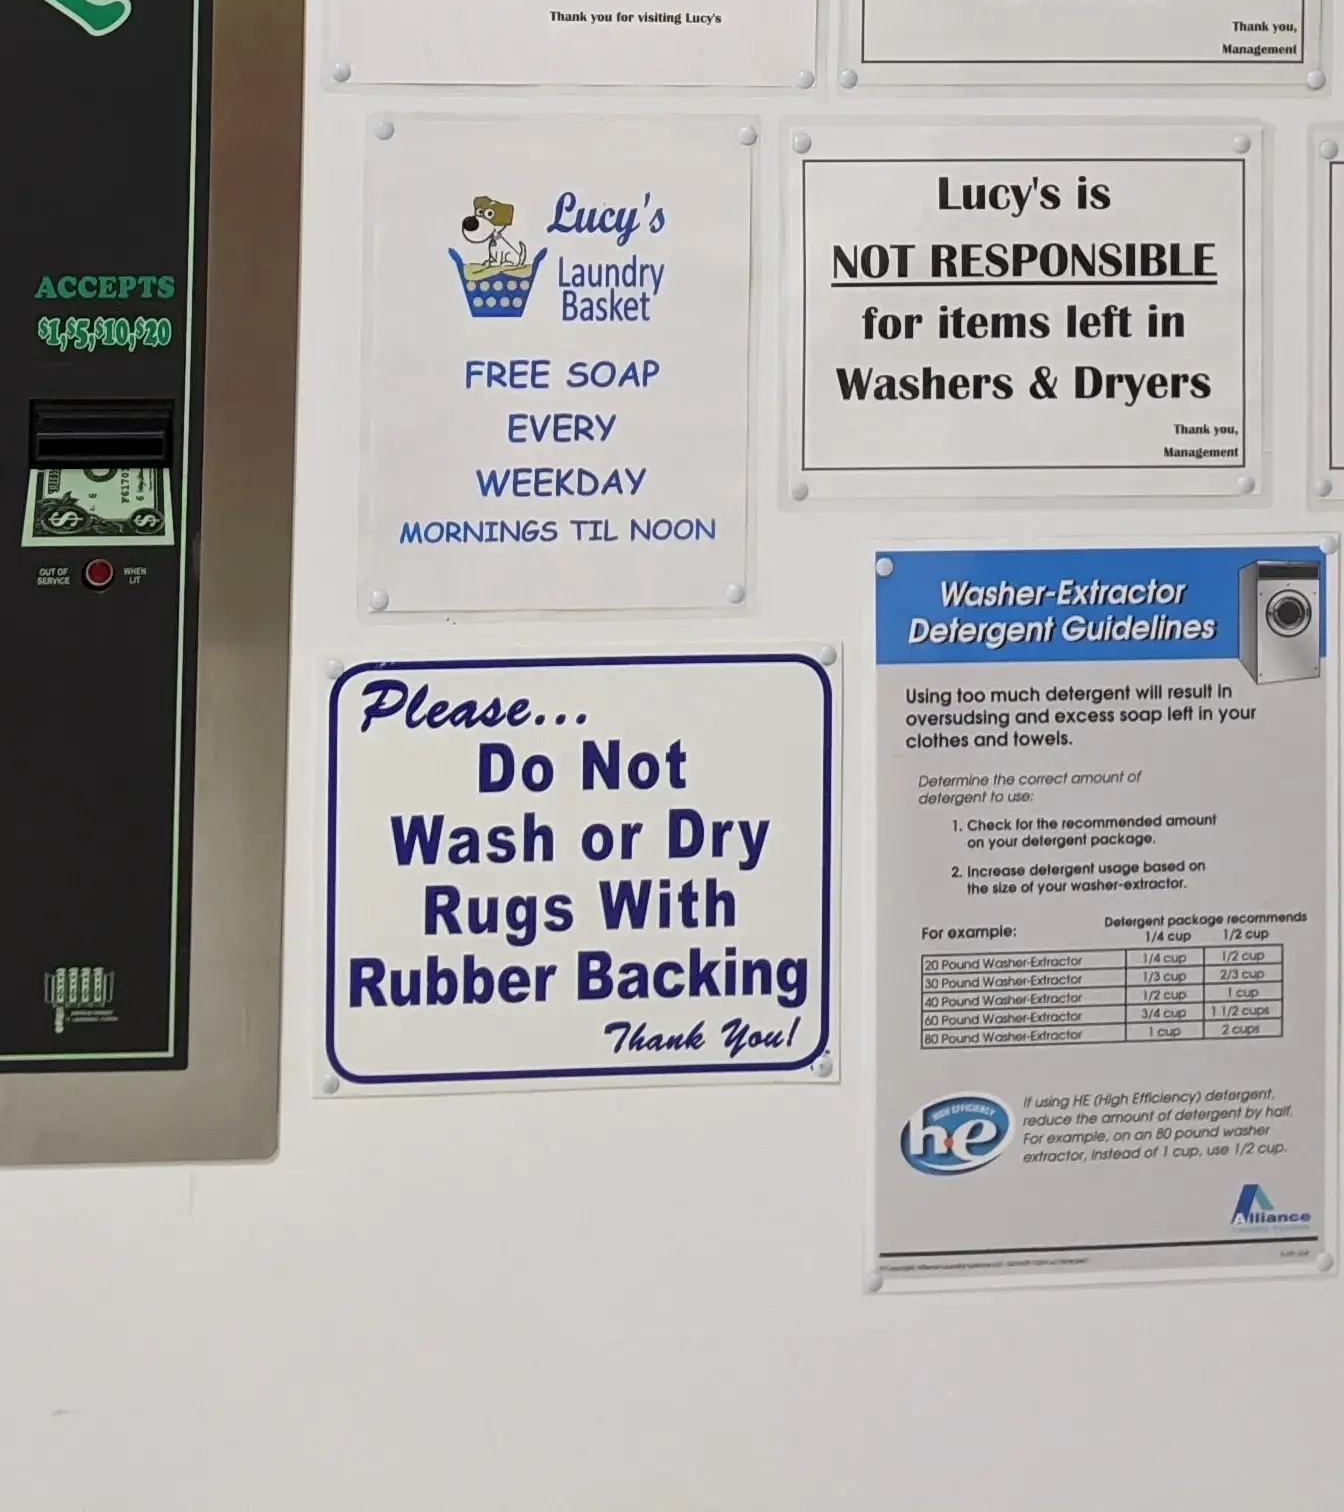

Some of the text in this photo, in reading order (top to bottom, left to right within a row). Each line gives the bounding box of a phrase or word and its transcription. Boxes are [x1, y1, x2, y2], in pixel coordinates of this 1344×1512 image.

[939, 176, 1110, 218] Lucy's is
[547, 192, 665, 247] Lucy's
[559, 254, 664, 296] Laundry
[833, 243, 1216, 278] NOT RESPONSIBLE
[35, 276, 175, 299] ACCEPTS
[562, 288, 650, 321] Basket
[38, 317, 171, 352] $1,$5,$10,$20
[862, 304, 1184, 340] for items left in
[466, 360, 659, 389] FREE SOAP
[836, 366, 1211, 407] Washers & Dryers
[508, 413, 616, 443] EVERY
[1174, 424, 1238, 436] Thank you,
[1164, 447, 1238, 459] Management
[476, 468, 646, 497] WEEKDAY
[400, 518, 715, 544] MORNINGS TIL NOON
[361, 679, 586, 733] Please...
[479, 739, 686, 793] Do Not
[391, 808, 770, 871] Wash or Dry
[425, 878, 735, 947] Rugs With
[349, 947, 807, 1008] Rubber Backing
[604, 1016, 801, 1059] Thank You!
